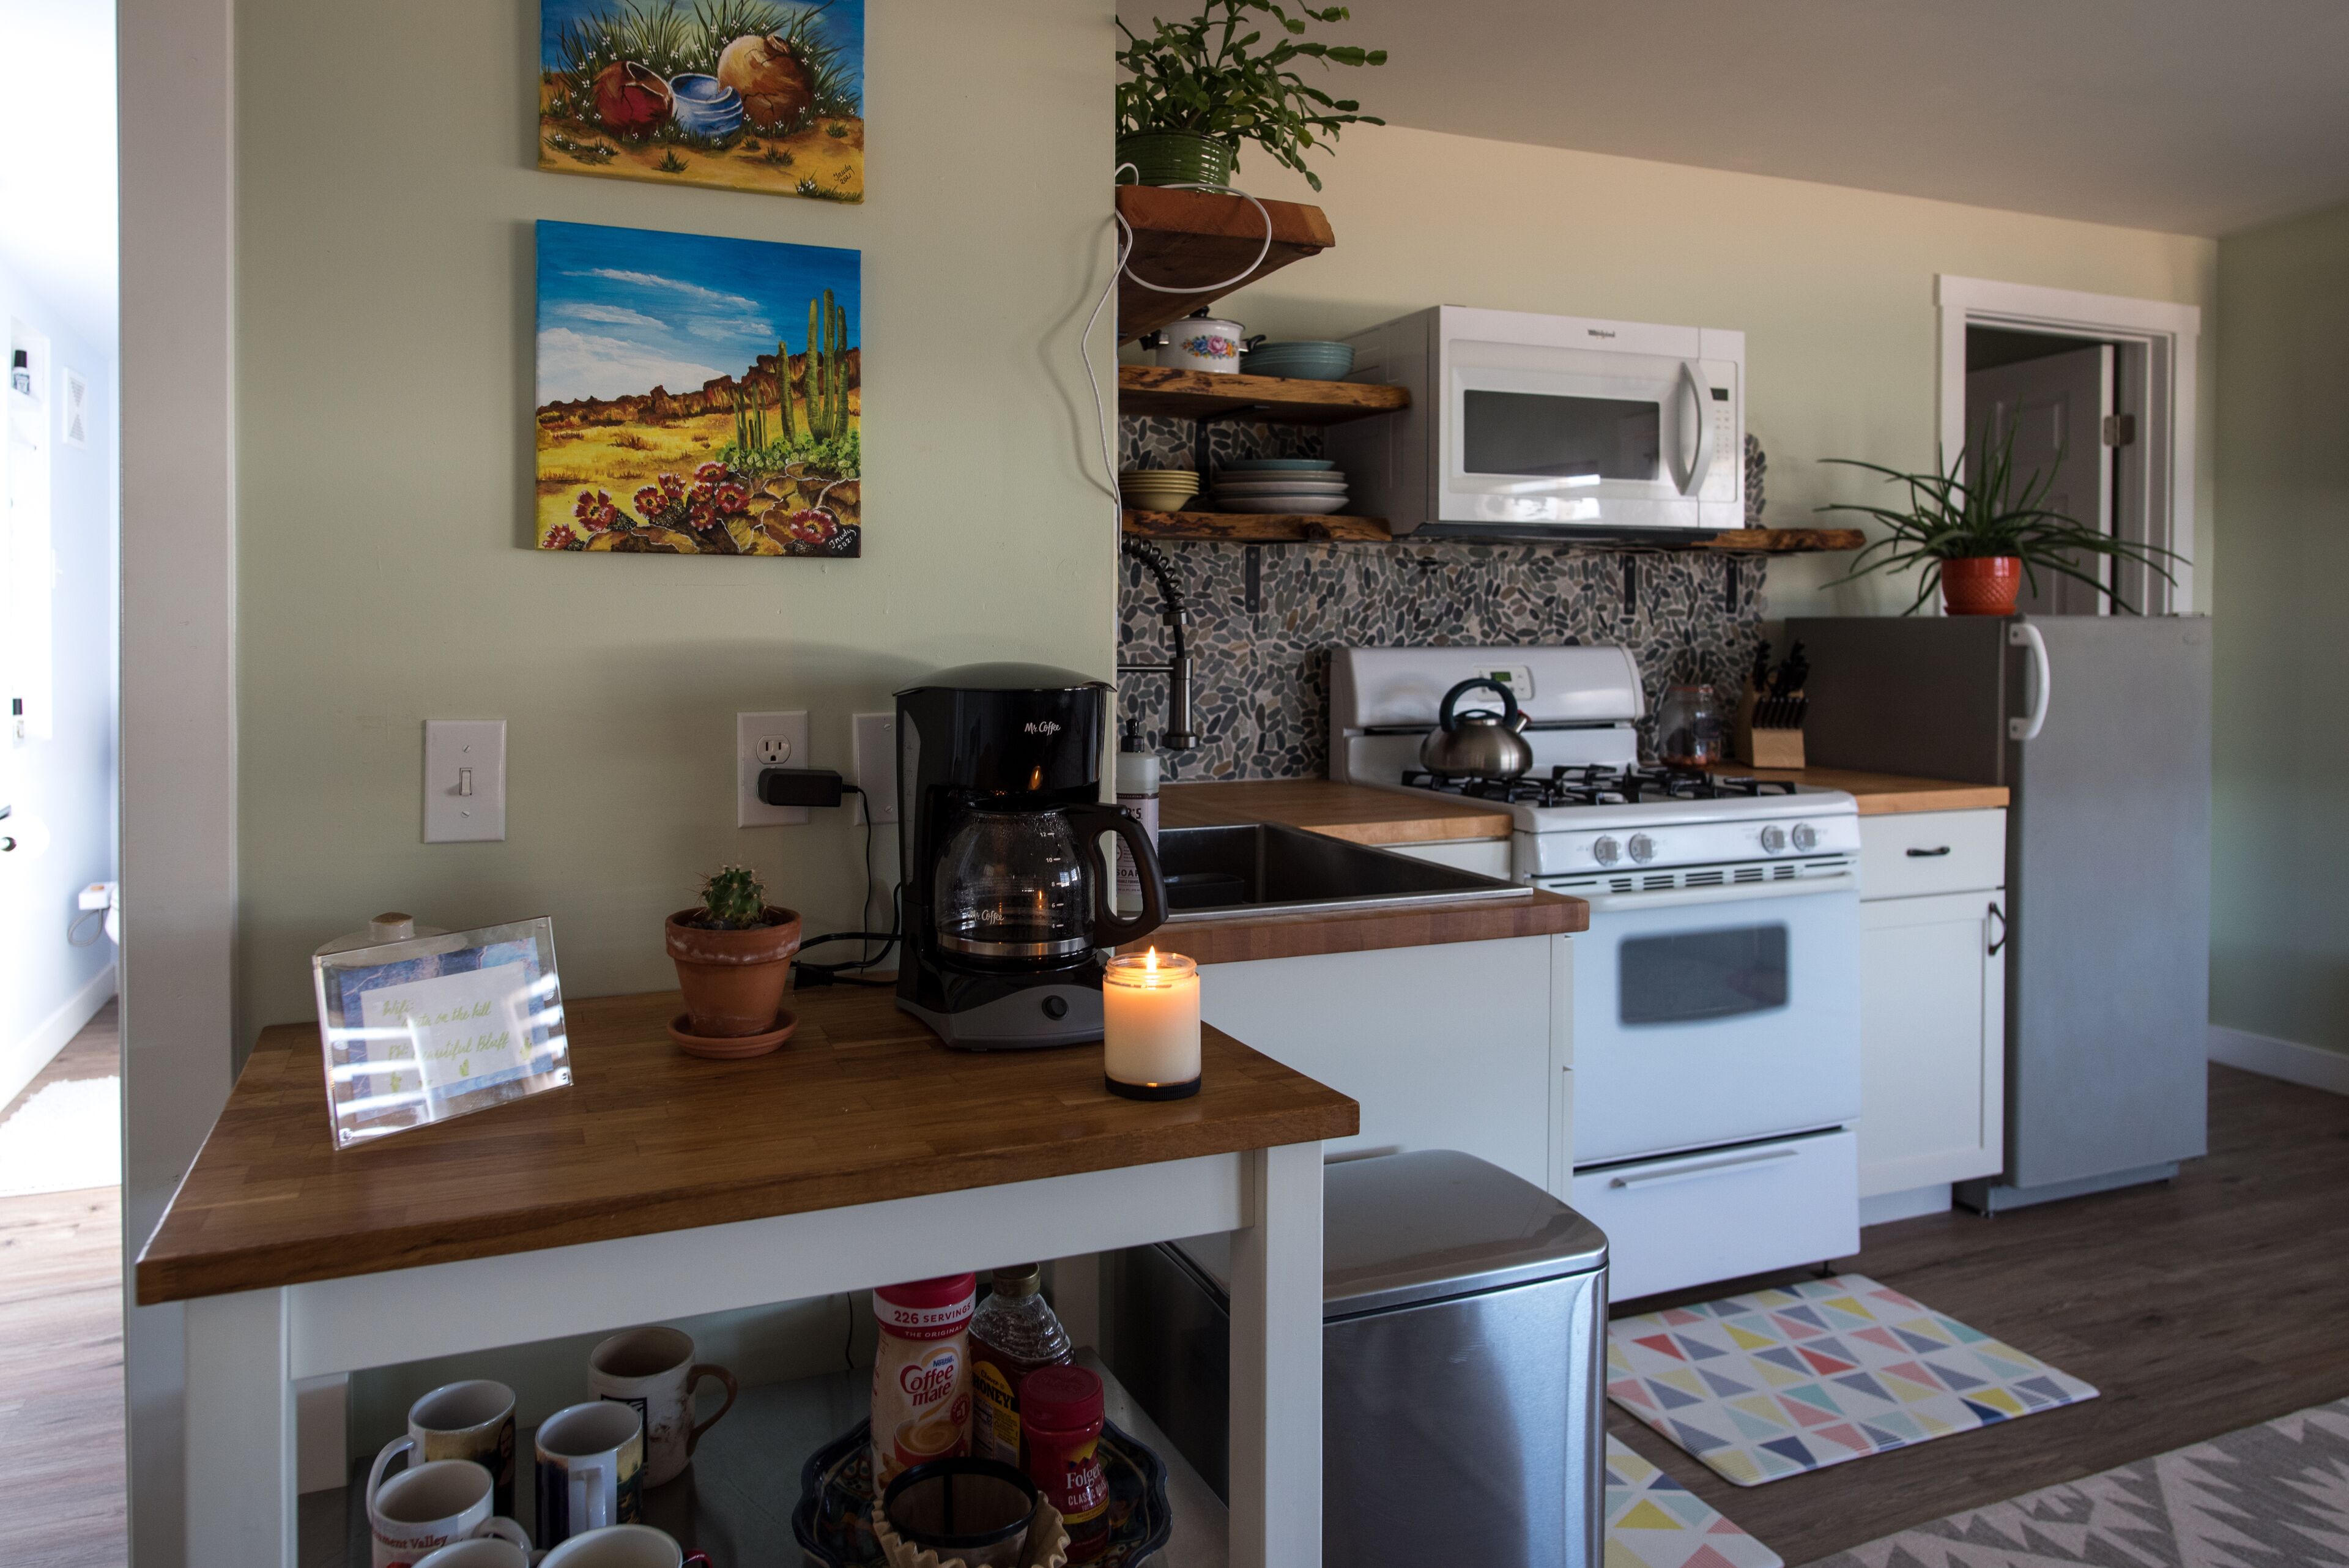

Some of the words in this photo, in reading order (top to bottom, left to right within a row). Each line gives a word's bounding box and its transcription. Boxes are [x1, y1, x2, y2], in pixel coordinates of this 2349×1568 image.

[1024, 722, 1038, 735] Mr.
[1039, 721, 1061, 736] Coffee
[981, 909, 1004, 925] Coffee
[435, 1013, 449, 1025] on
[451, 1006, 470, 1022] the
[471, 1000, 492, 1019] hill
[894, 1310, 919, 1325] 226
[924, 1325, 963, 1339] ORIGINAL
[900, 1365, 954, 1394] Coffee
[912, 1381, 951, 1406] mate
[973, 1372, 1011, 1409] HONEY
[1068, 1488, 1096, 1506] CLASC
[410, 1534, 448, 1549] Valley
